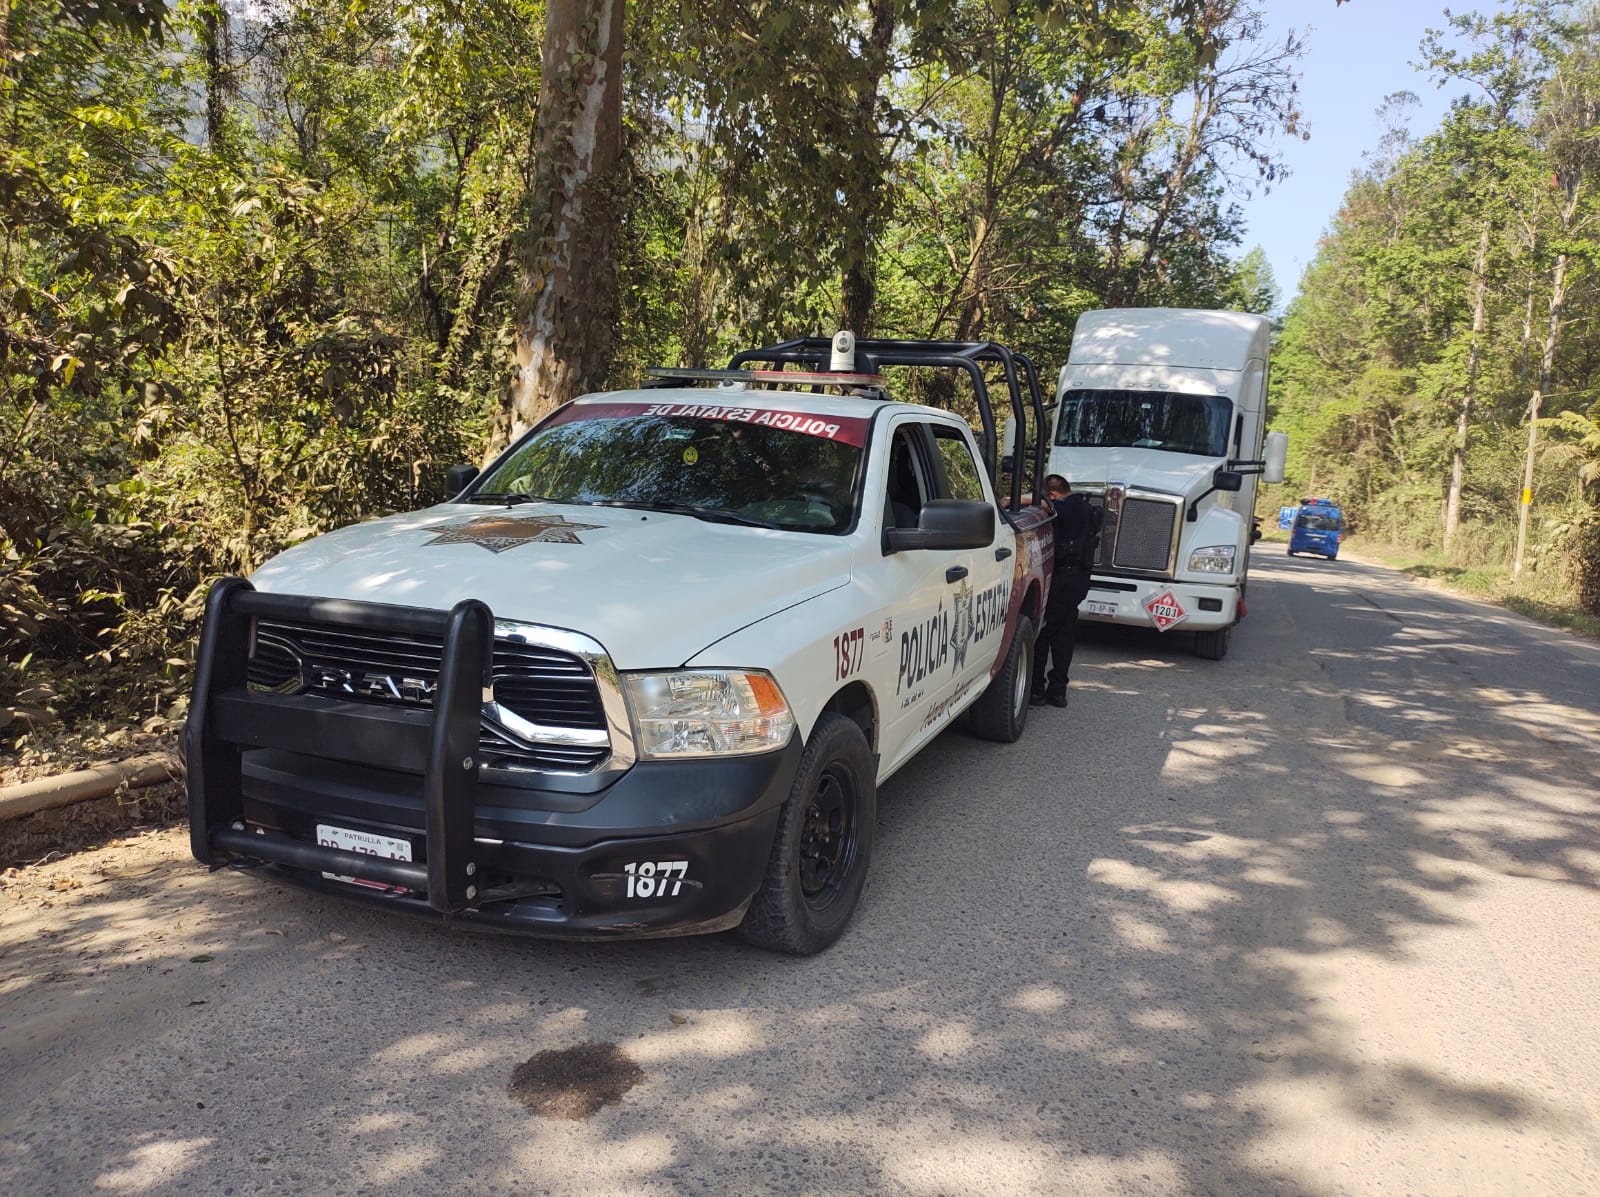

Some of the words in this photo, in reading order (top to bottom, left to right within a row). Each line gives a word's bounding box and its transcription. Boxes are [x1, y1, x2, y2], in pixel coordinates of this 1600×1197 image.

[1155, 605, 1177, 618] 1203
[833, 627, 865, 682] 1877
[896, 598, 949, 697] POLICÍA
[344, 832, 382, 845] PATRULLA
[624, 861, 689, 898] 1877
